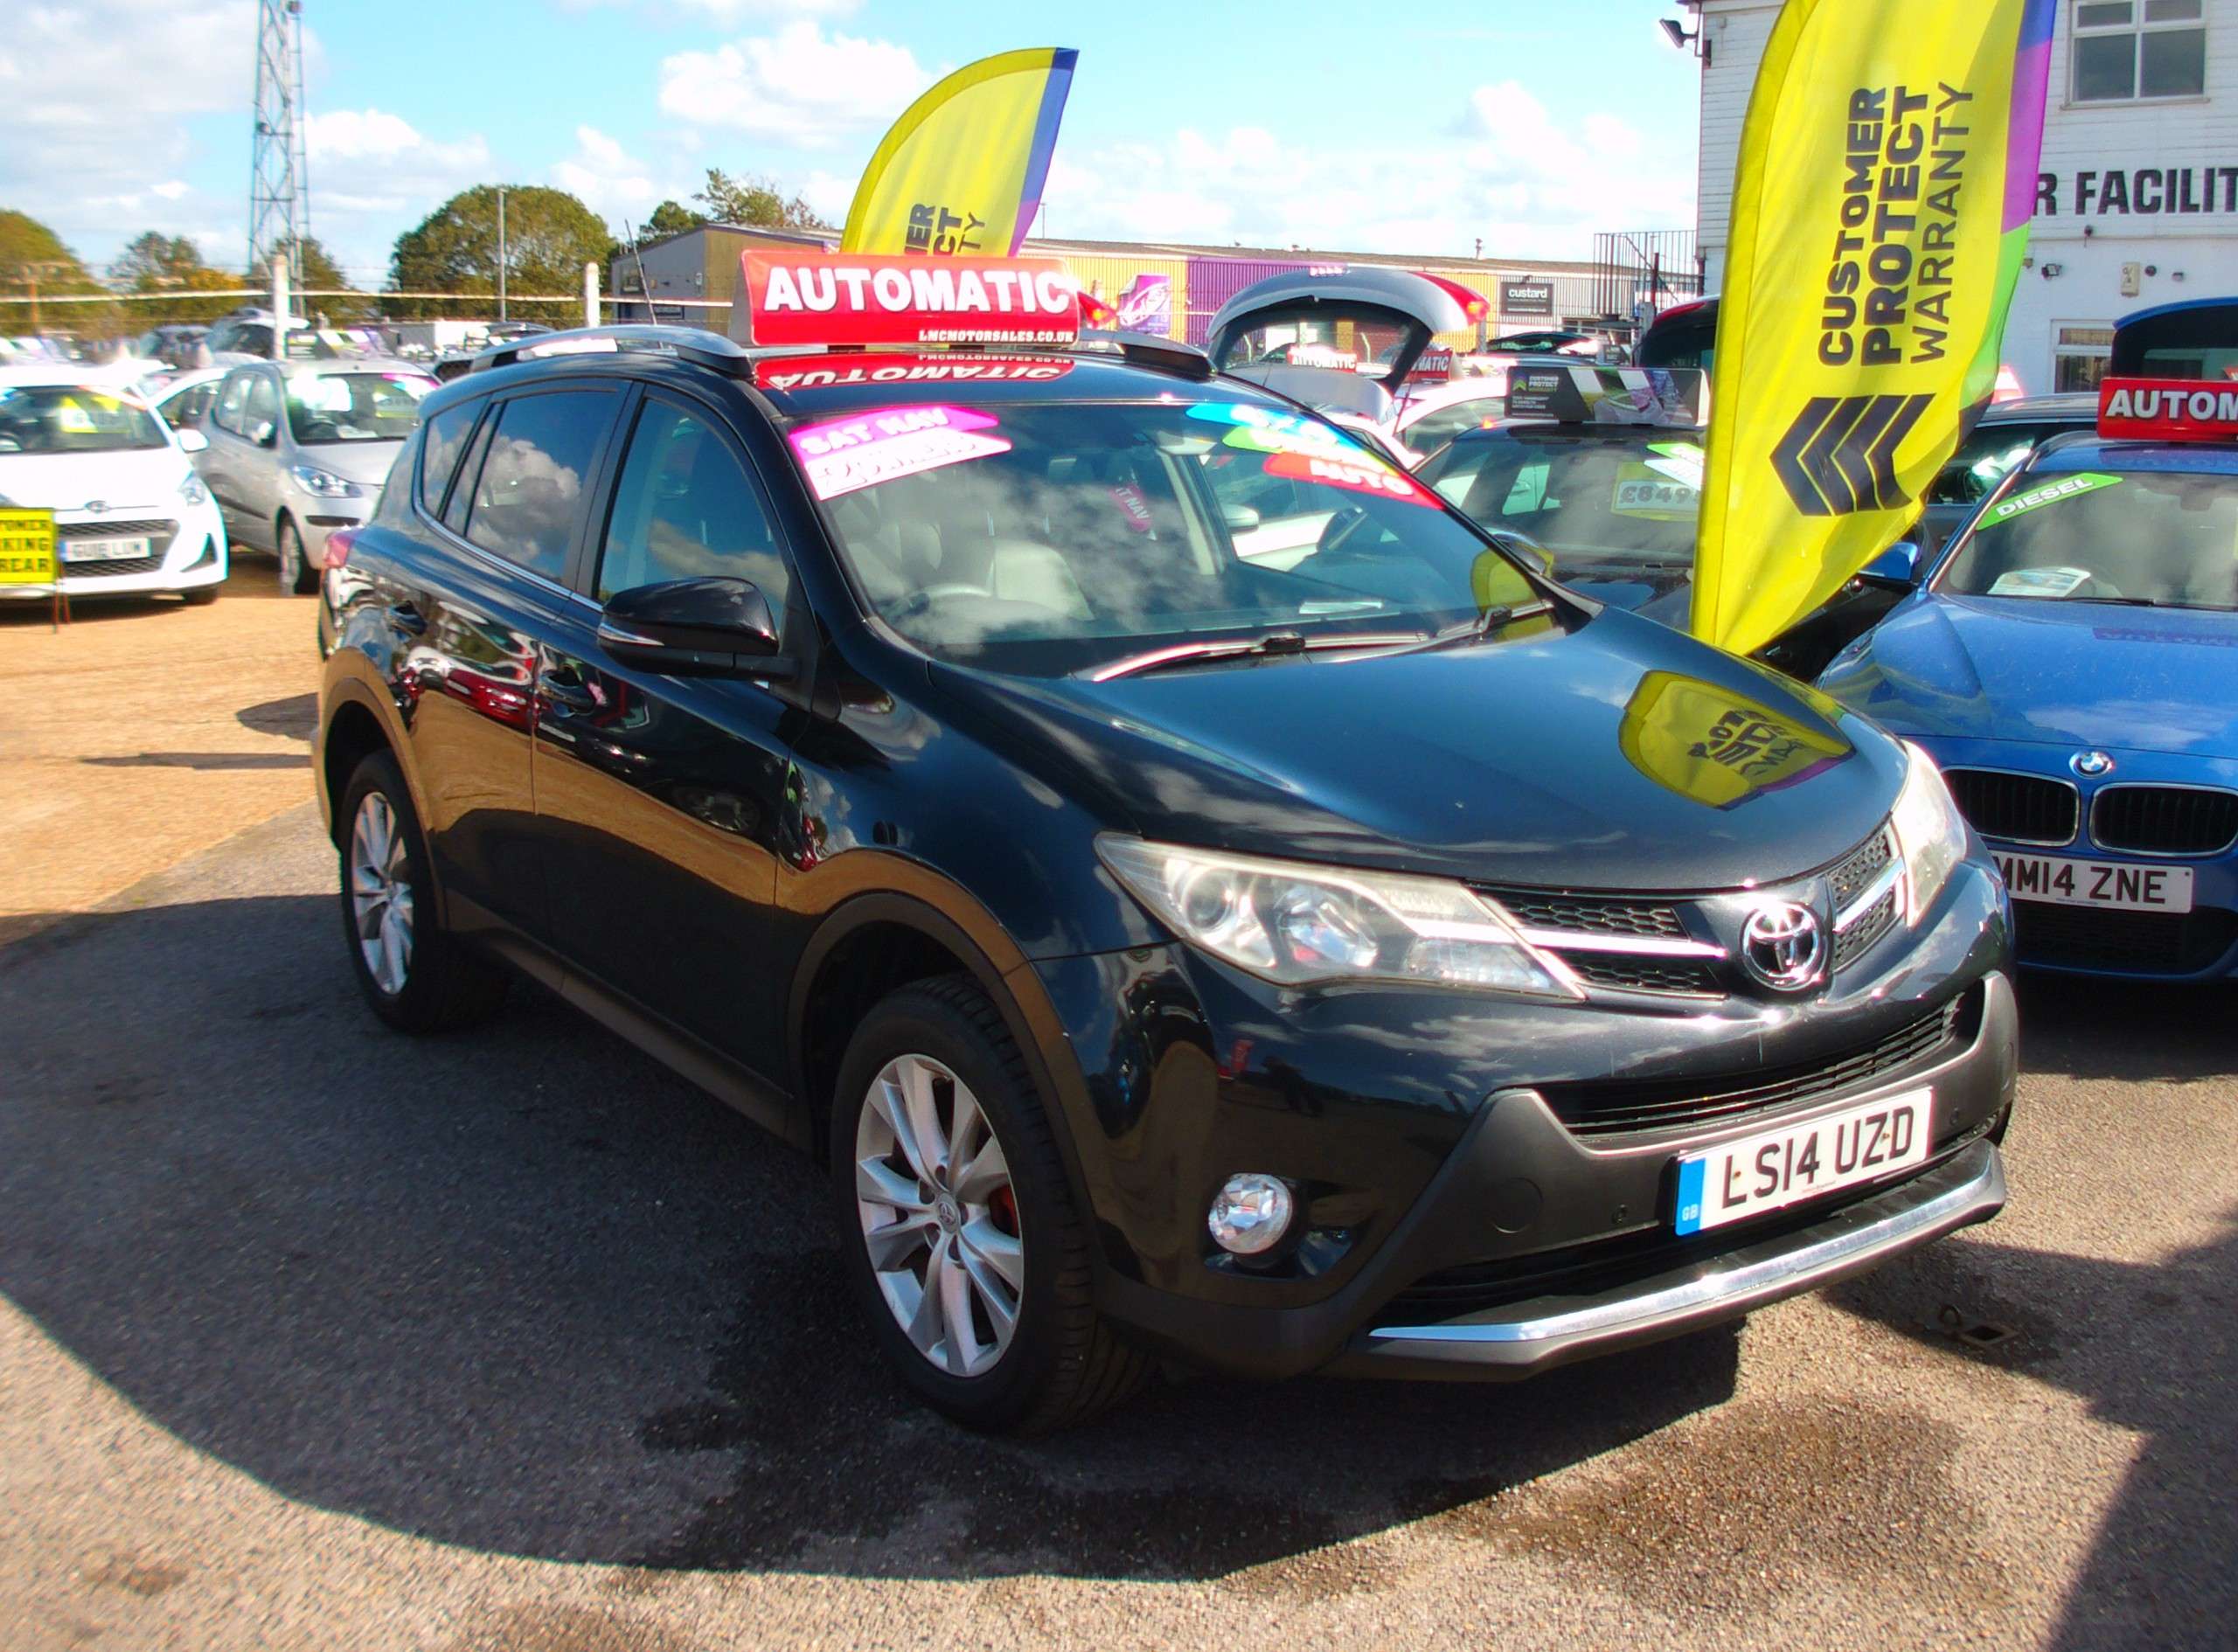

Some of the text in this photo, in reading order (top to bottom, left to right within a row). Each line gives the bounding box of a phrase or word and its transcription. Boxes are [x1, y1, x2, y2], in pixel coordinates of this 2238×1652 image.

[2075, 167, 2238, 215] FACILIT
[904, 204, 935, 255] ER
[1818, 87, 1886, 366] CUSTOMER
[1860, 86, 1929, 366] PROTECT
[1910, 81, 1973, 364] WARRANTY
[763, 267, 1070, 313] AUTOMATIC
[1508, 288, 1547, 298] custard
[919, 330, 1074, 344] LMCMOTORSALES.CO.UK
[799, 408, 951, 455] SAT NAV
[1622, 485, 1699, 504] £849
[1996, 478, 2094, 517] DIESEL
[2089, 866, 2167, 904] ZNE
[1722, 1106, 1914, 1209] LS14 UZD
[1681, 1204, 1699, 1222] GB
